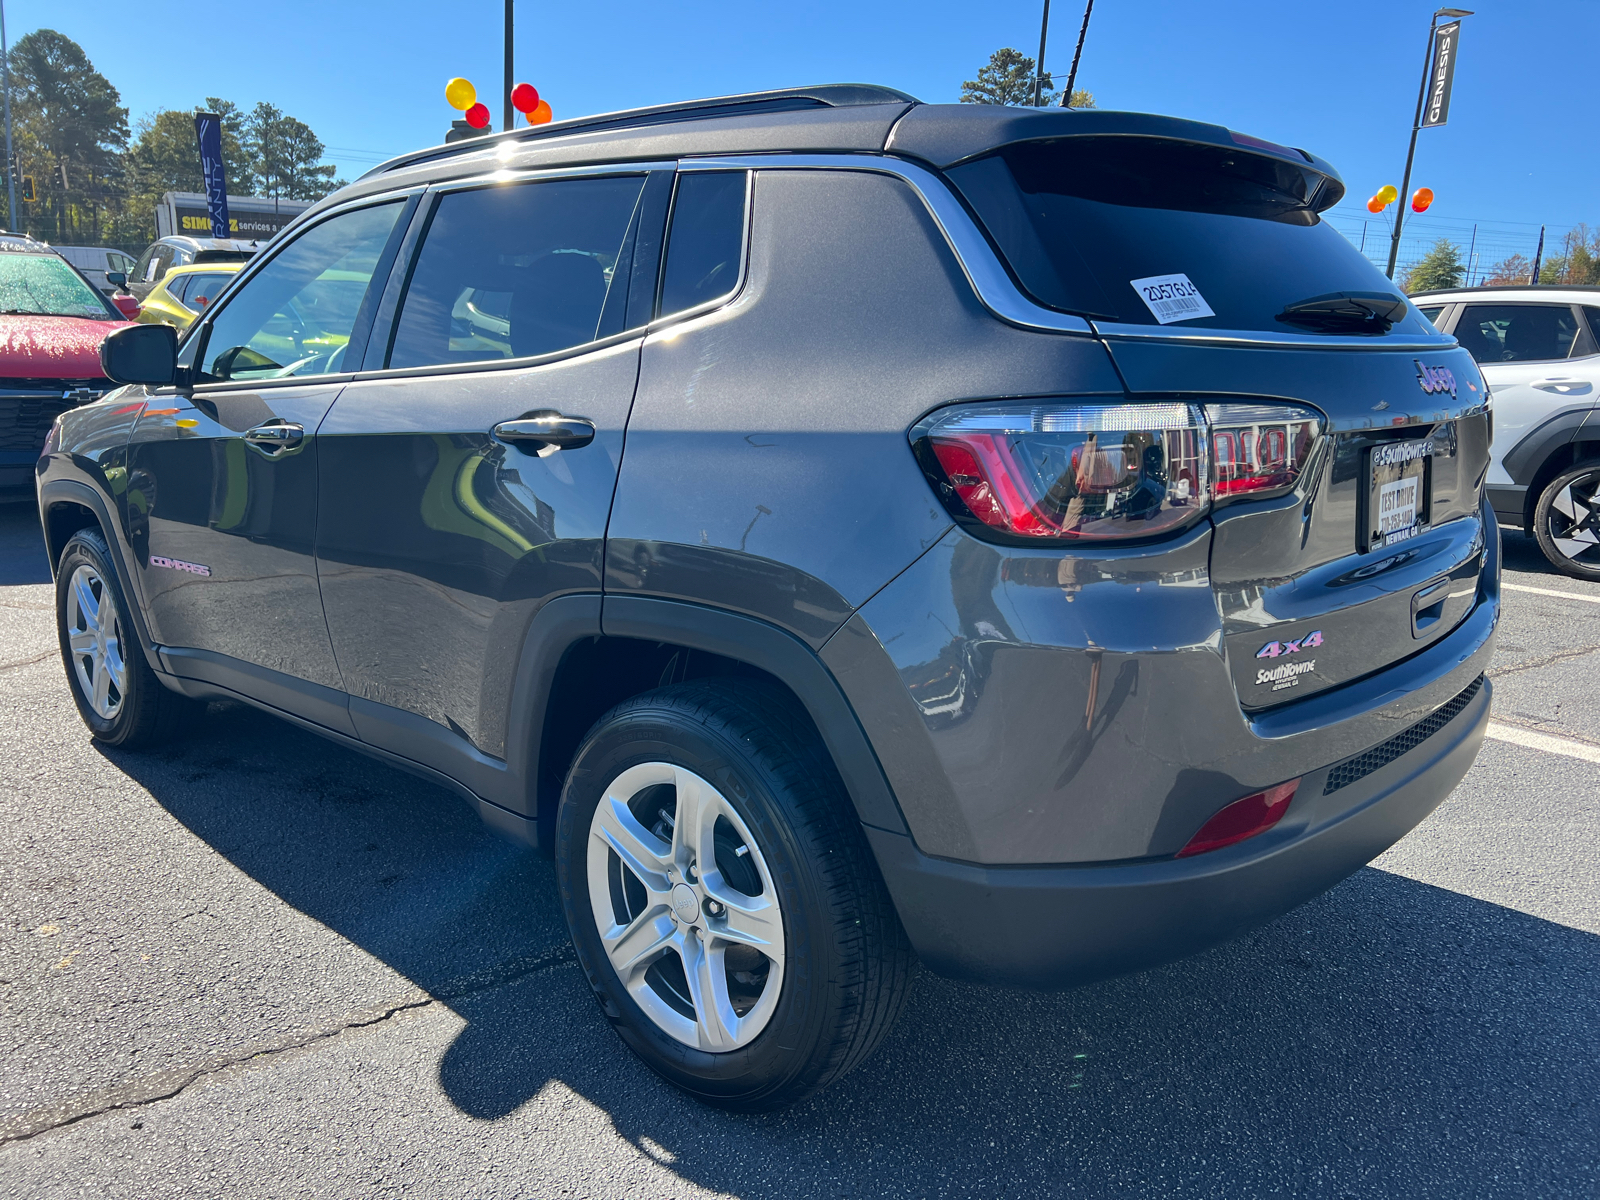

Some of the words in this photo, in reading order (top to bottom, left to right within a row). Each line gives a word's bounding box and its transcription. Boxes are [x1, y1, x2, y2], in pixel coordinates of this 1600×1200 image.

[1430, 36, 1451, 123] GENESIS
[238, 221, 271, 232] services
[1413, 359, 1457, 400] Jeep
[1381, 490, 1395, 513] TEST
[1396, 485, 1415, 508] DRIVE
[1410, 526, 1418, 537] GA
[150, 555, 212, 577] COMPASS
[1255, 630, 1324, 659] 4x4
